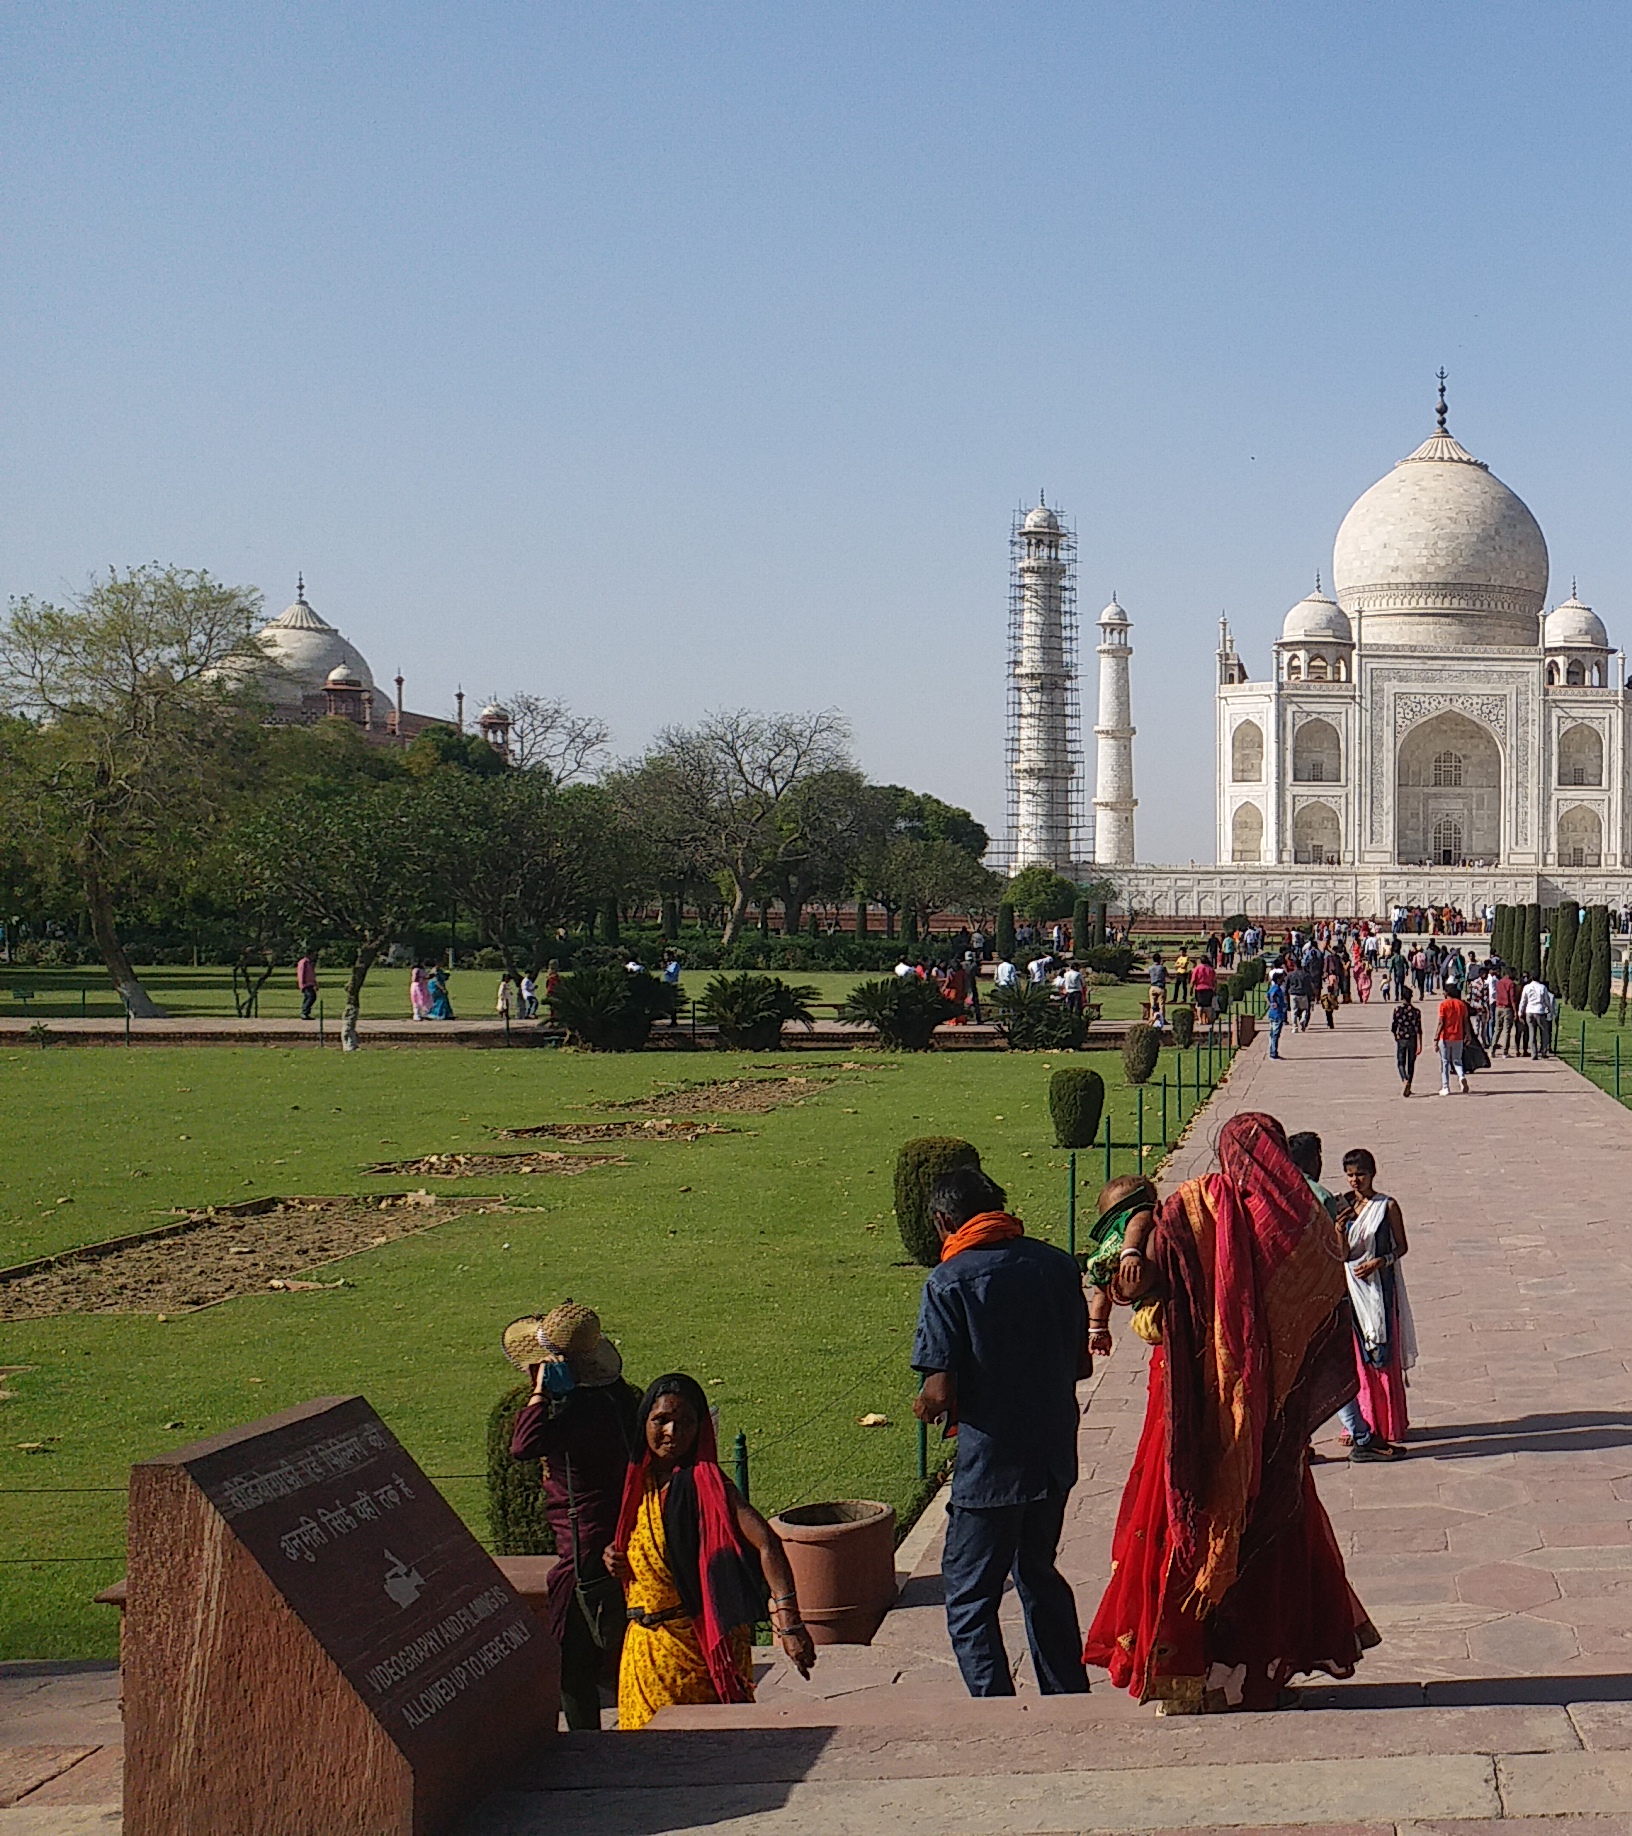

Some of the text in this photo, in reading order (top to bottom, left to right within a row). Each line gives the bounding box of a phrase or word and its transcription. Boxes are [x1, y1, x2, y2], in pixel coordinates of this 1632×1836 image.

[280, 1516, 329, 1562] अनुमति
[318, 1499, 358, 1538] सिर्फ
[372, 1484, 402, 1510] तक
[391, 1472, 416, 1499] है
[365, 1585, 509, 1693] VIDEOGRAPHY AND FILMING IS
[401, 1619, 532, 1730] ALLOWED UP TO HERE ONLY
